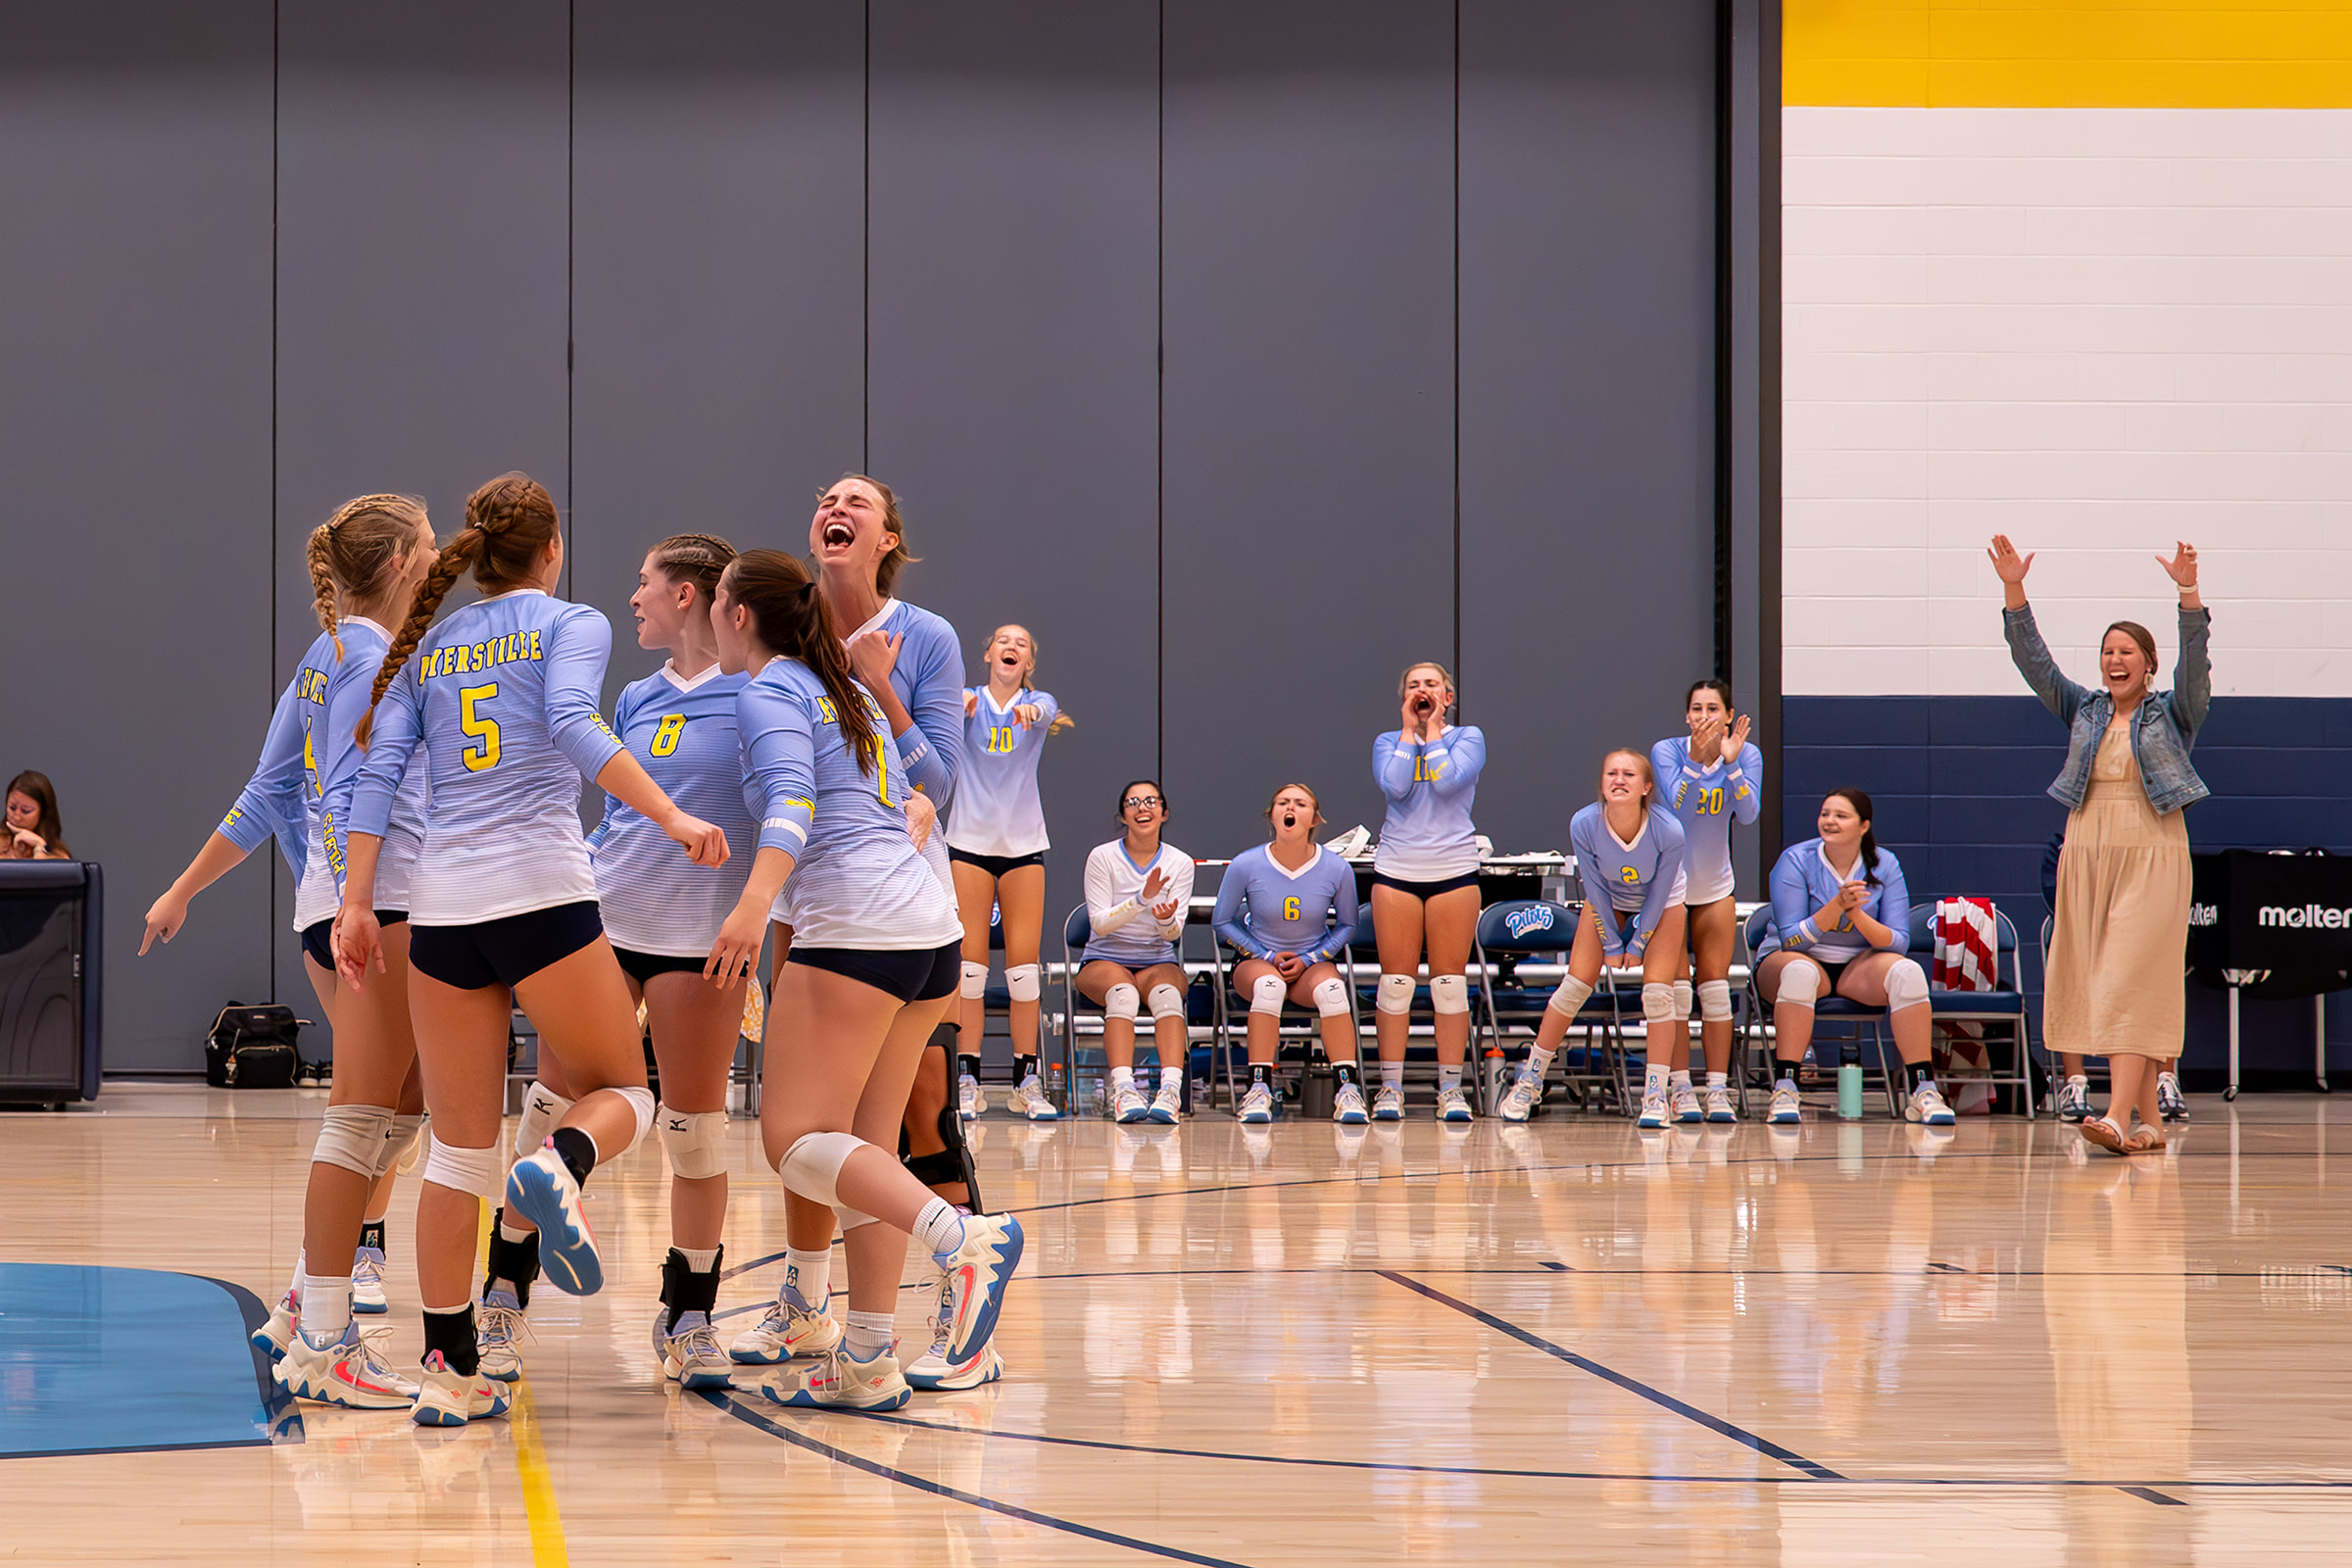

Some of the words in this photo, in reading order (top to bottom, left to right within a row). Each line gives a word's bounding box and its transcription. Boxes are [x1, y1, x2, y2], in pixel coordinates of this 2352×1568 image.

[460, 681, 502, 773] 5
[649, 712, 689, 759] 8
[987, 725, 1014, 754] 10
[1695, 786, 1725, 815] 20
[1620, 864, 1641, 885] 2
[1283, 895, 1301, 921] 6
[1504, 904, 1554, 939] Pilots
[2187, 902, 2218, 926] olten
